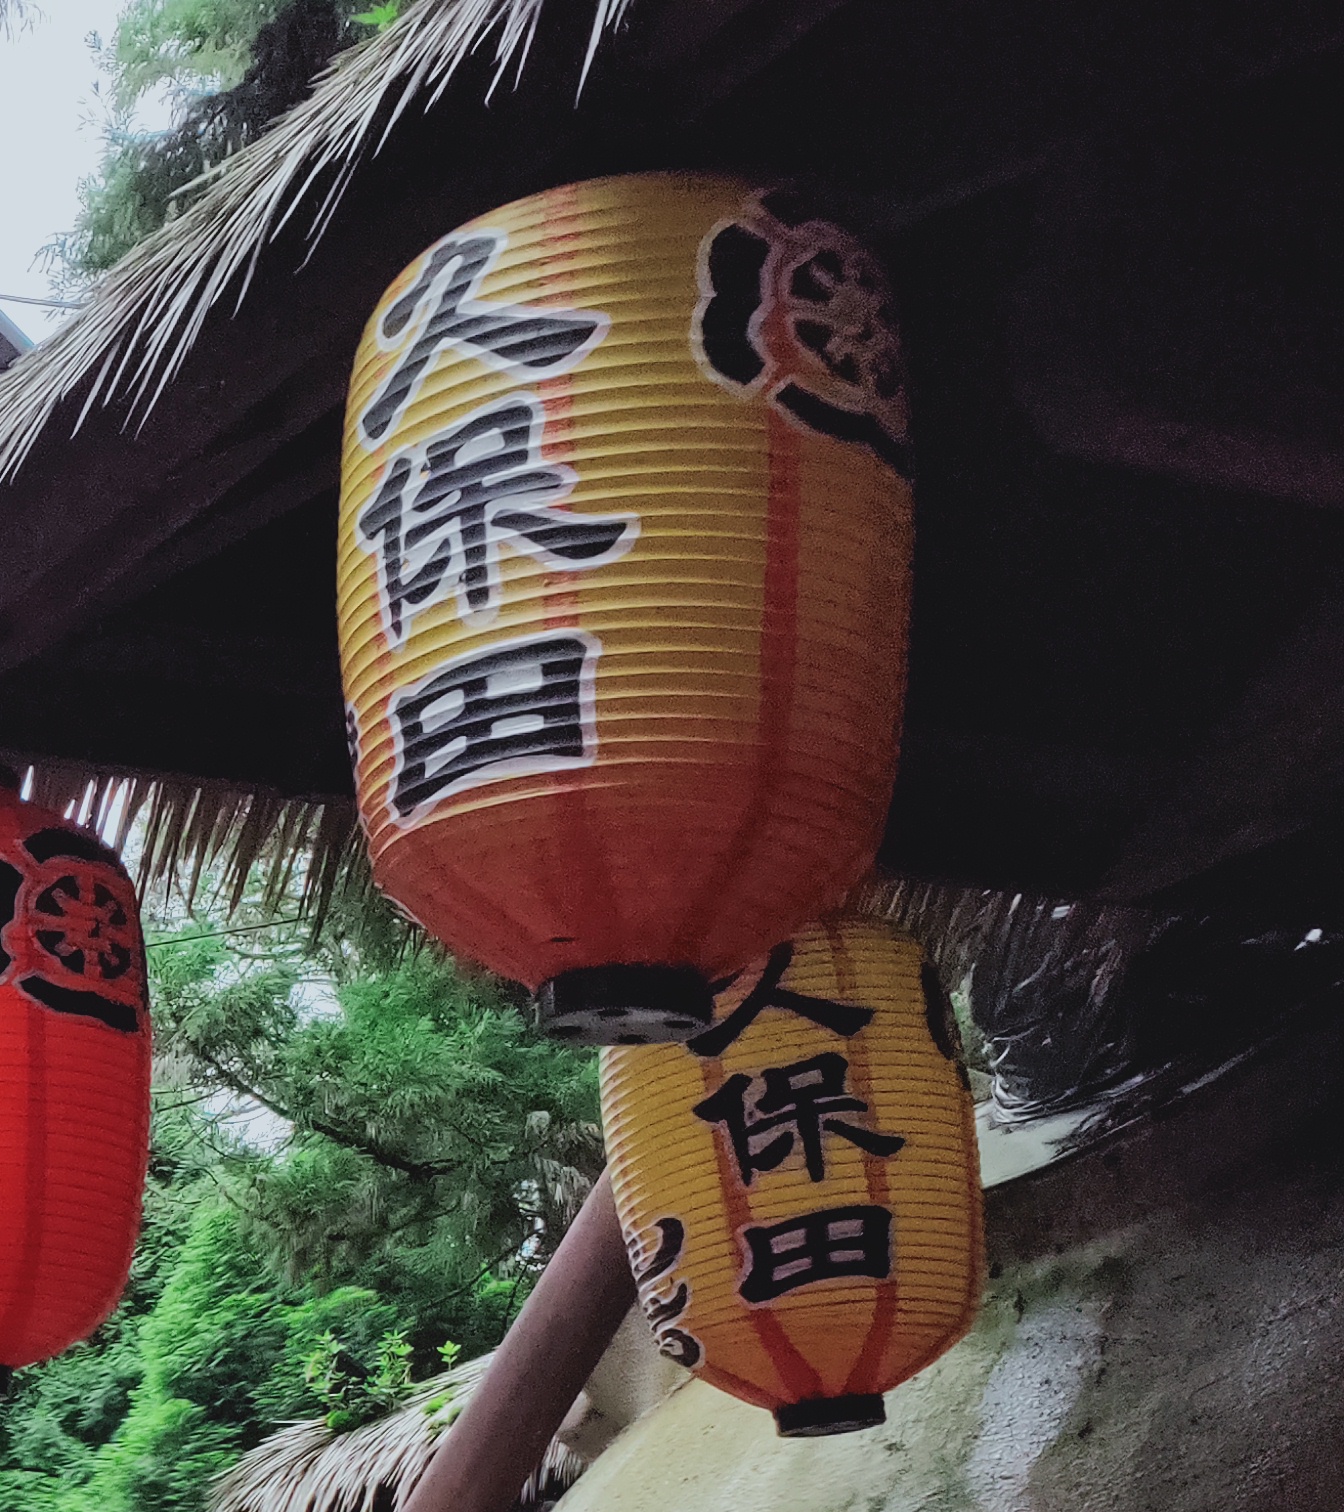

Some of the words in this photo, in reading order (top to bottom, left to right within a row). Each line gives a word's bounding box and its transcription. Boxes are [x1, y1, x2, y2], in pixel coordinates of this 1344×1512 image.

[356, 226, 640, 832] 久保田
[685, 941, 906, 1304] 久保田
